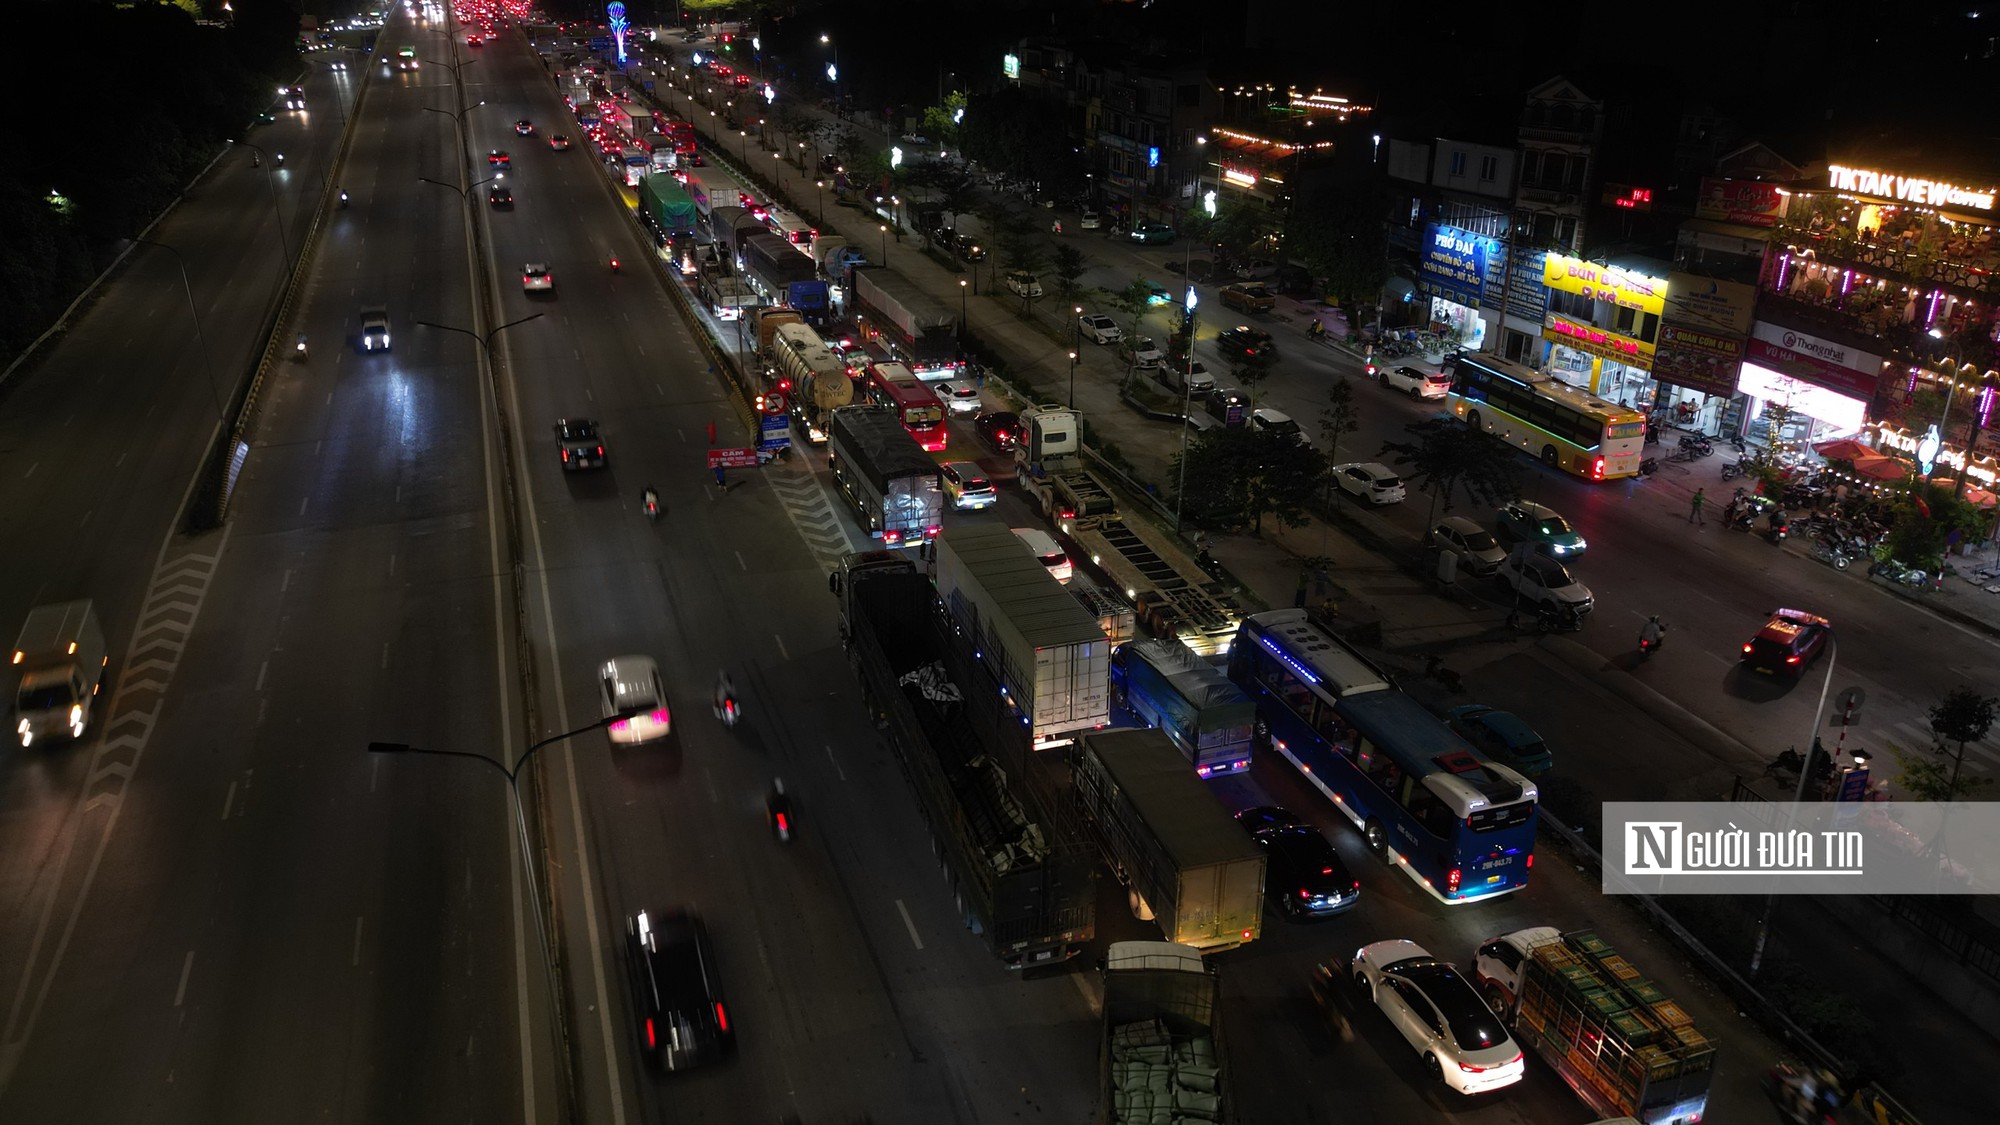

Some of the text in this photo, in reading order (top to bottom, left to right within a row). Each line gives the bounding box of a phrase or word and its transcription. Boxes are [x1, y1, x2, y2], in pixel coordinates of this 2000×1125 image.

[1828, 164, 1895, 198] TIKTAK
[1896, 176, 1951, 206] VIEW
[1455, 239, 1475, 256] ĐẠI
[1568, 265, 1596, 282] BÚN
[1676, 330, 1698, 343] QUÁN
[1698, 336, 1716, 348] CƠM
[1796, 337, 1845, 361] Thongnhat
[1880, 428, 1917, 454] TIKTA
